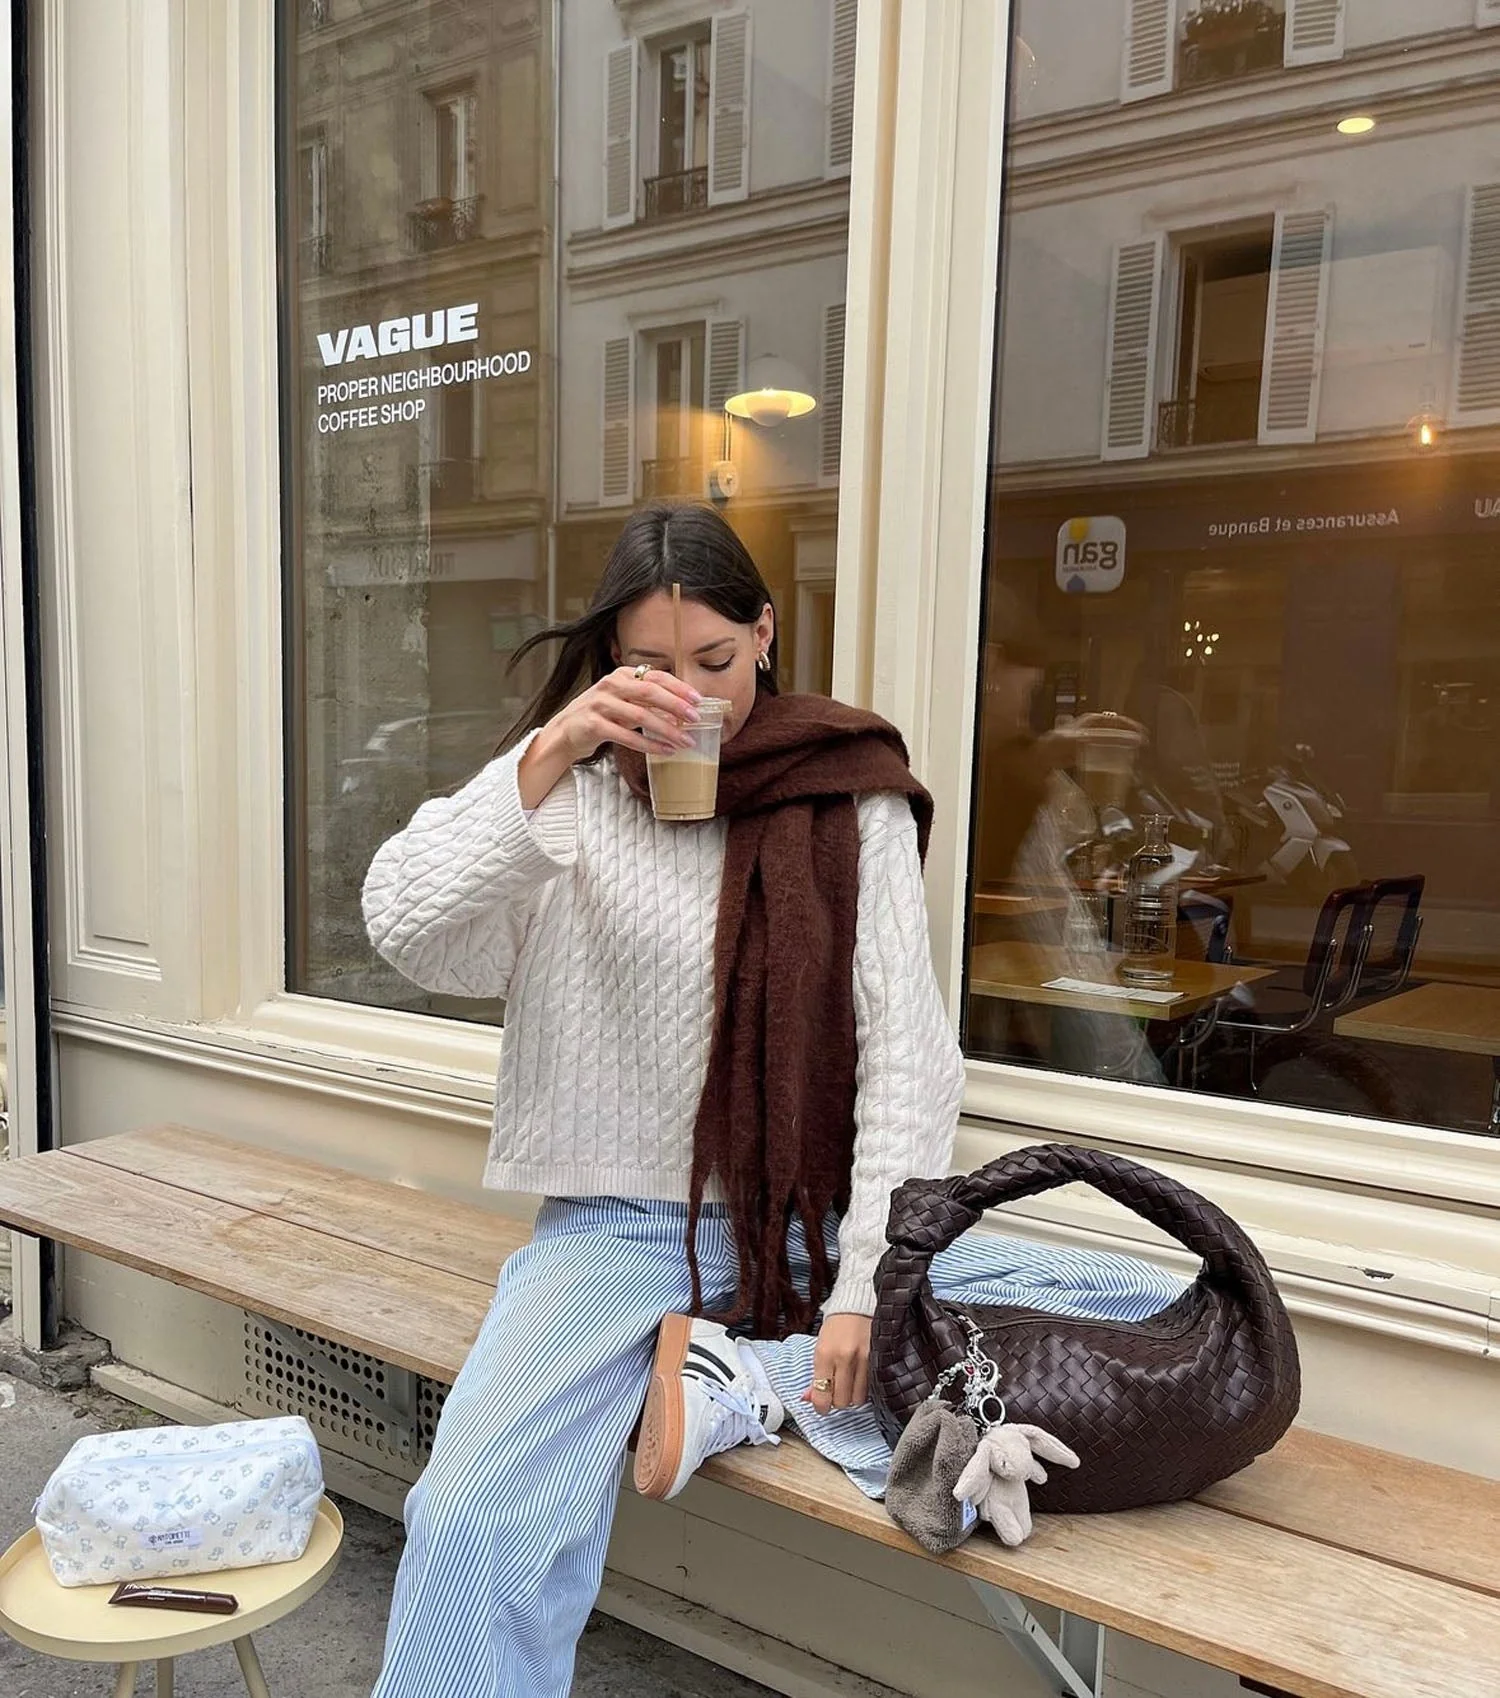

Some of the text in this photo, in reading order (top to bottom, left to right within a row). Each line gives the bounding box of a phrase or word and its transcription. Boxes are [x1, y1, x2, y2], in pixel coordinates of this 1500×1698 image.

[317, 303, 478, 367] VAGUE
[318, 350, 531, 405] PROPER NEIGHBOURHOOD
[318, 399, 426, 433] COFFEE SHOP
